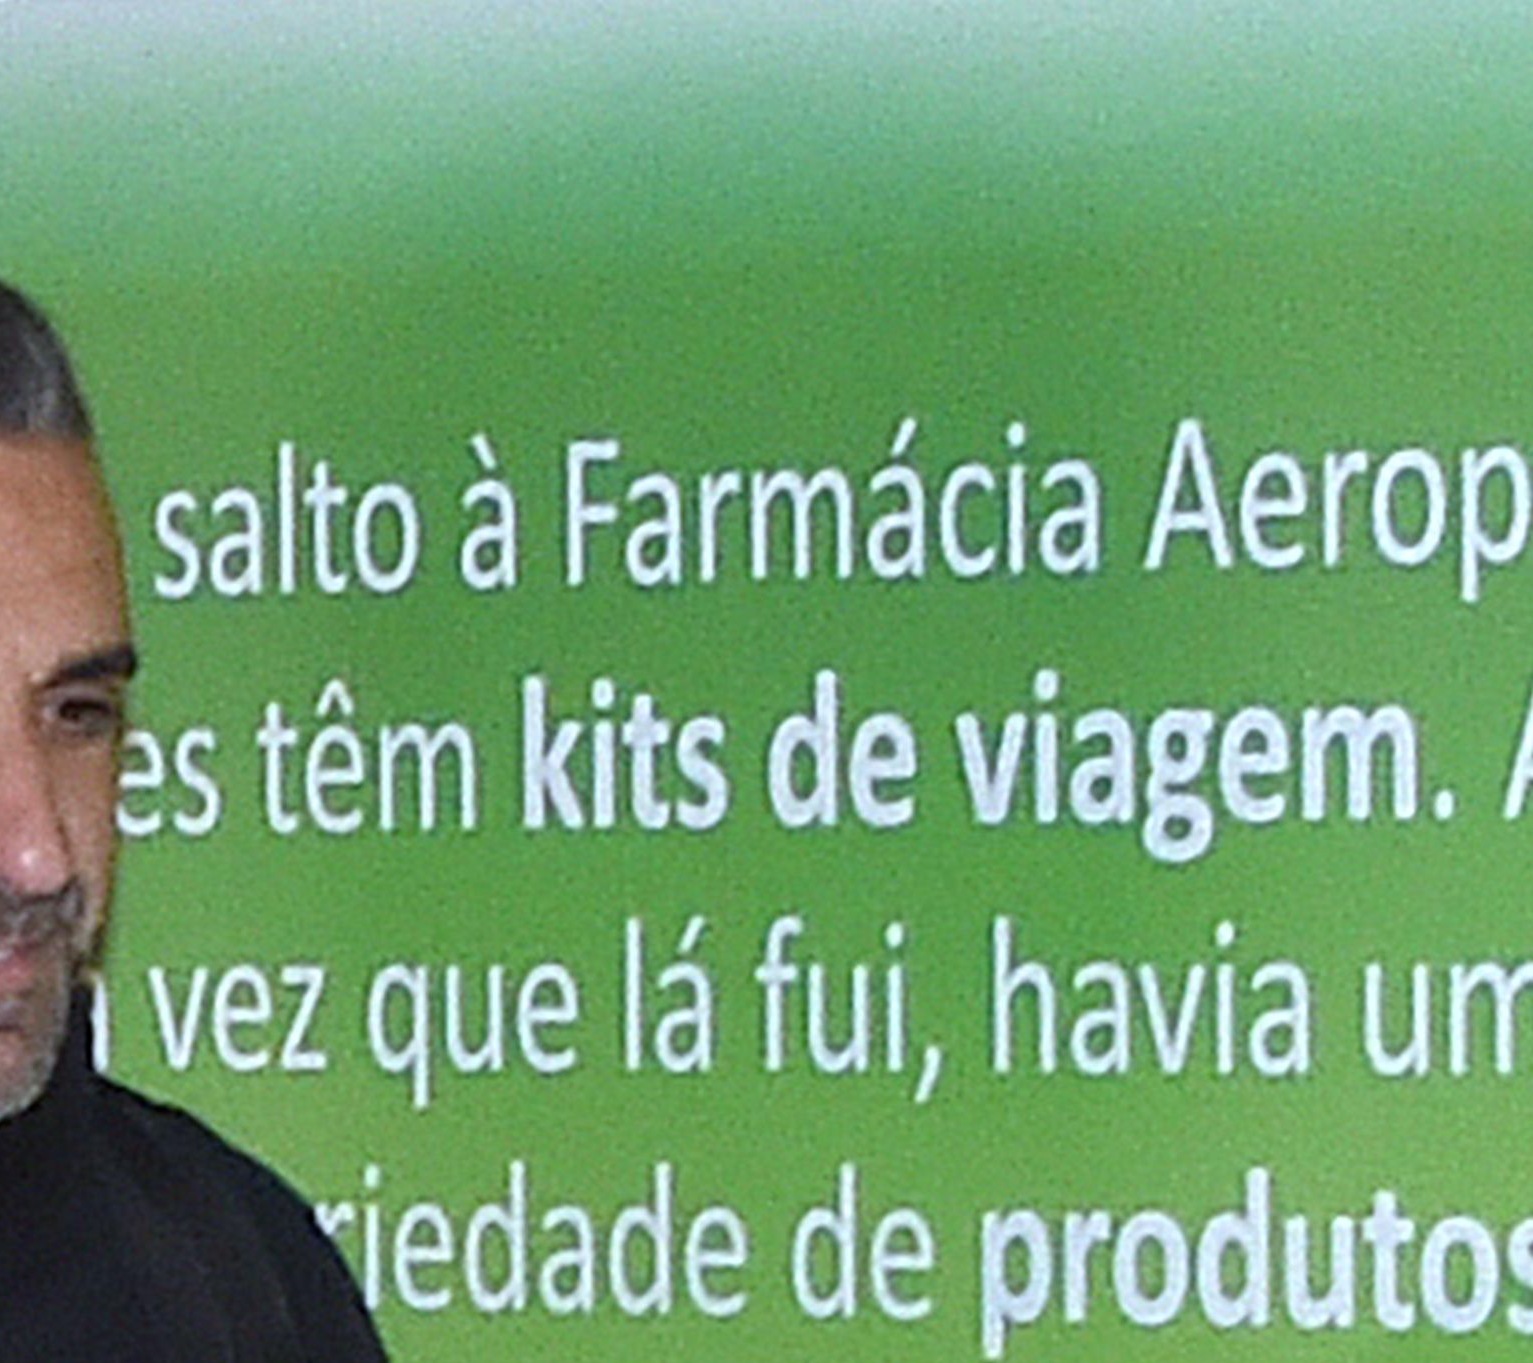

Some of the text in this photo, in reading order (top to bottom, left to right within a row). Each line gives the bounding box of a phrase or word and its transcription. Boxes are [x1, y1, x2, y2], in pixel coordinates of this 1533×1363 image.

[154, 417, 1533, 603] salto à Farmácia Aerop
[115, 728, 221, 836] es
[256, 679, 477, 834] têm
[523, 675, 729, 829] kits
[768, 669, 917, 828] de
[956, 669, 1455, 862] viagem.
[148, 964, 327, 1072] vez
[367, 963, 578, 1109] que
[626, 915, 713, 1073] lá
[755, 915, 942, 1103] fui,
[994, 916, 1311, 1076] havia
[1364, 961, 1533, 1077] um
[793, 1162, 935, 1320] de
